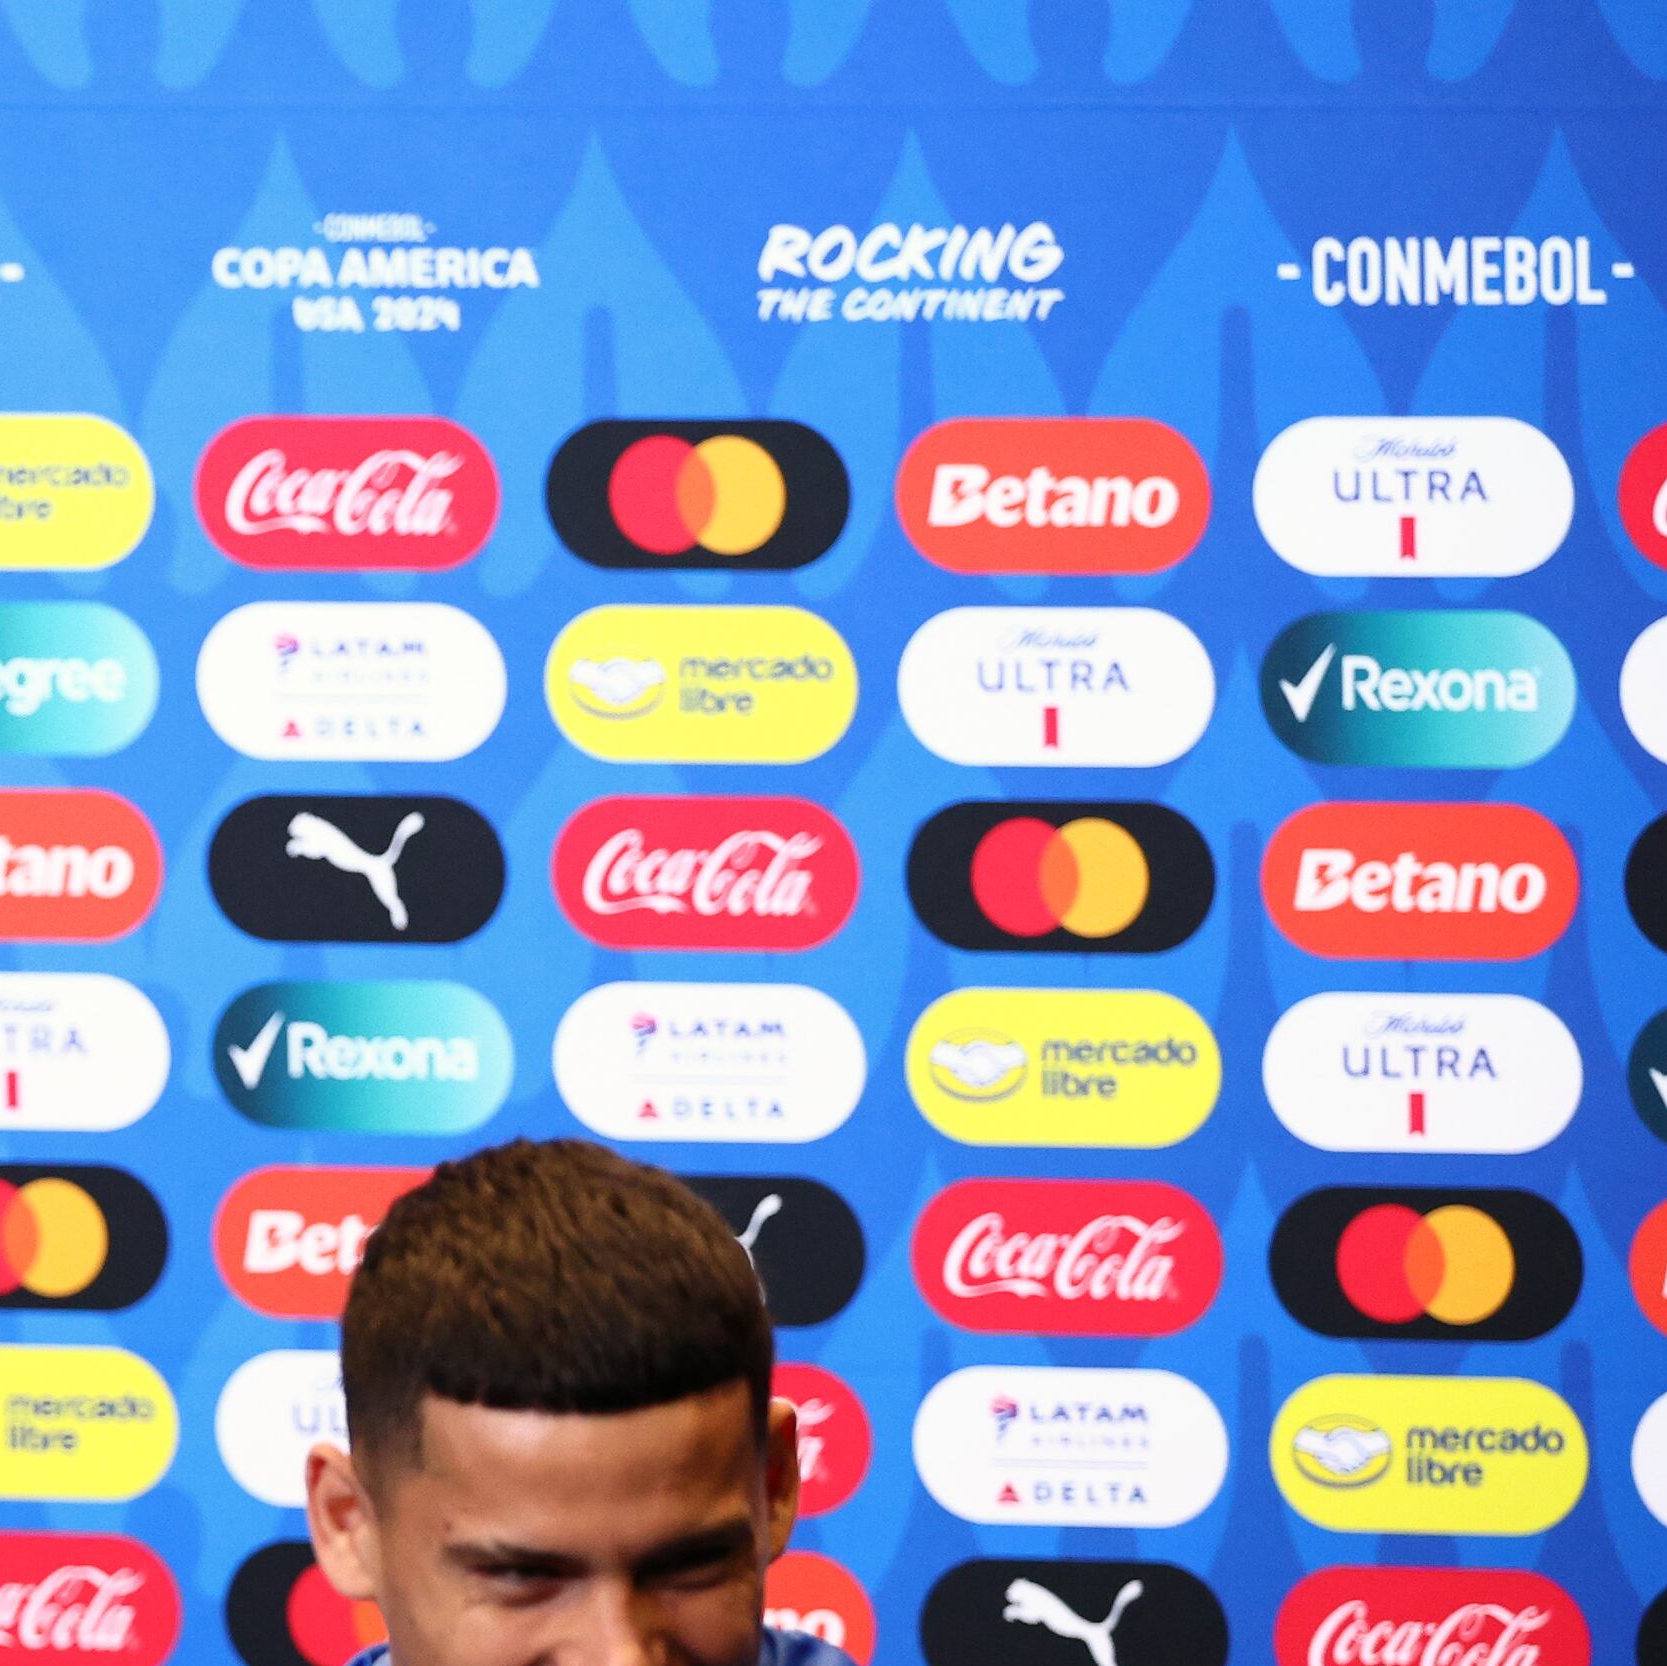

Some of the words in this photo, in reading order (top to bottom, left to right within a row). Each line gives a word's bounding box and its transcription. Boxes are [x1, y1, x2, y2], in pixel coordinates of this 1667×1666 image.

[212, 246, 334, 289] COPA
[336, 247, 540, 290] AMERICA
[755, 220, 1065, 283] ROCKING
[1311, 234, 1608, 308] CONMEBOL
[291, 294, 364, 333] USA
[371, 296, 463, 333] 2024
[757, 287, 835, 322] THE
[841, 287, 1065, 322] CONTINENT
[928, 464, 1178, 527] Betano
[1334, 469, 1489, 504] ULTRA
[679, 654, 833, 683] mercado
[977, 659, 1131, 694] ULTRA
[1339, 655, 1539, 712] Rexona
[679, 688, 755, 715] libre
[1294, 849, 1546, 913] Betano
[669, 1019, 787, 1038] LATAM
[286, 1023, 478, 1080] Rexona
[1042, 1038, 1197, 1066] mercado
[1343, 1045, 1498, 1080] ULTRA
[1042, 1071, 1119, 1098] libre
[672, 1097, 785, 1119] DELTA
[243, 1207, 379, 1275] Bet
[6, 1393, 154, 1421] mercado
[1030, 1403, 1148, 1423] LATAM
[1406, 1424, 1565, 1453] mercado
[1406, 1458, 1485, 1486] libre
[1034, 1482, 1147, 1504] DELTA
